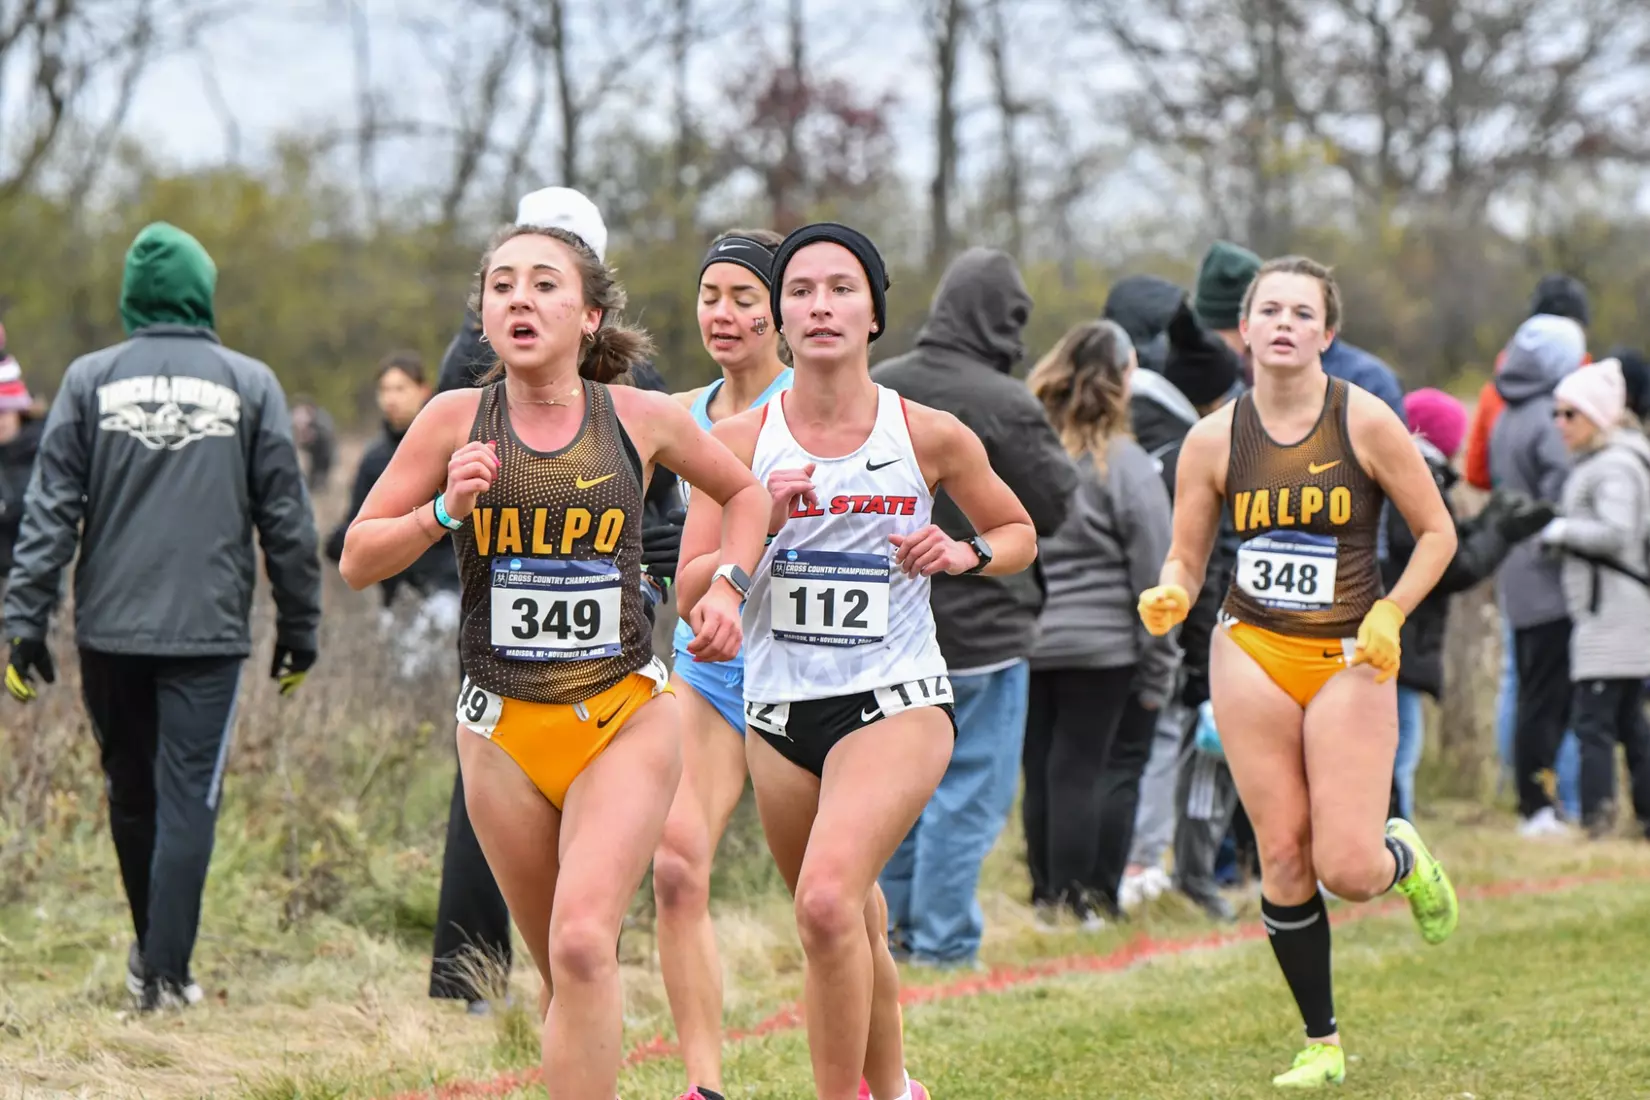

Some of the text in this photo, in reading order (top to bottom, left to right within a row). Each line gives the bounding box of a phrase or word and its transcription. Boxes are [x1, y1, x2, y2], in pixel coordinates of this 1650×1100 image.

[829, 495, 918, 515] STATE
[1234, 486, 1351, 532] VALPO
[472, 507, 625, 556] VALPO
[508, 573, 531, 582] CROSS
[533, 575, 564, 584] COUNTRY
[565, 574, 620, 585] CHAMPIONSHIPS
[786, 564, 807, 572] CROSS
[808, 565, 836, 574] COUNTRY
[837, 567, 889, 576] CHAMPIONSHIPS
[1252, 559, 1319, 595] 348
[511, 597, 601, 640] 349
[789, 586, 869, 629] 112
[548, 650, 580, 658] NOVEMBER
[460, 685, 488, 722] 49
[890, 676, 947, 707] 112
